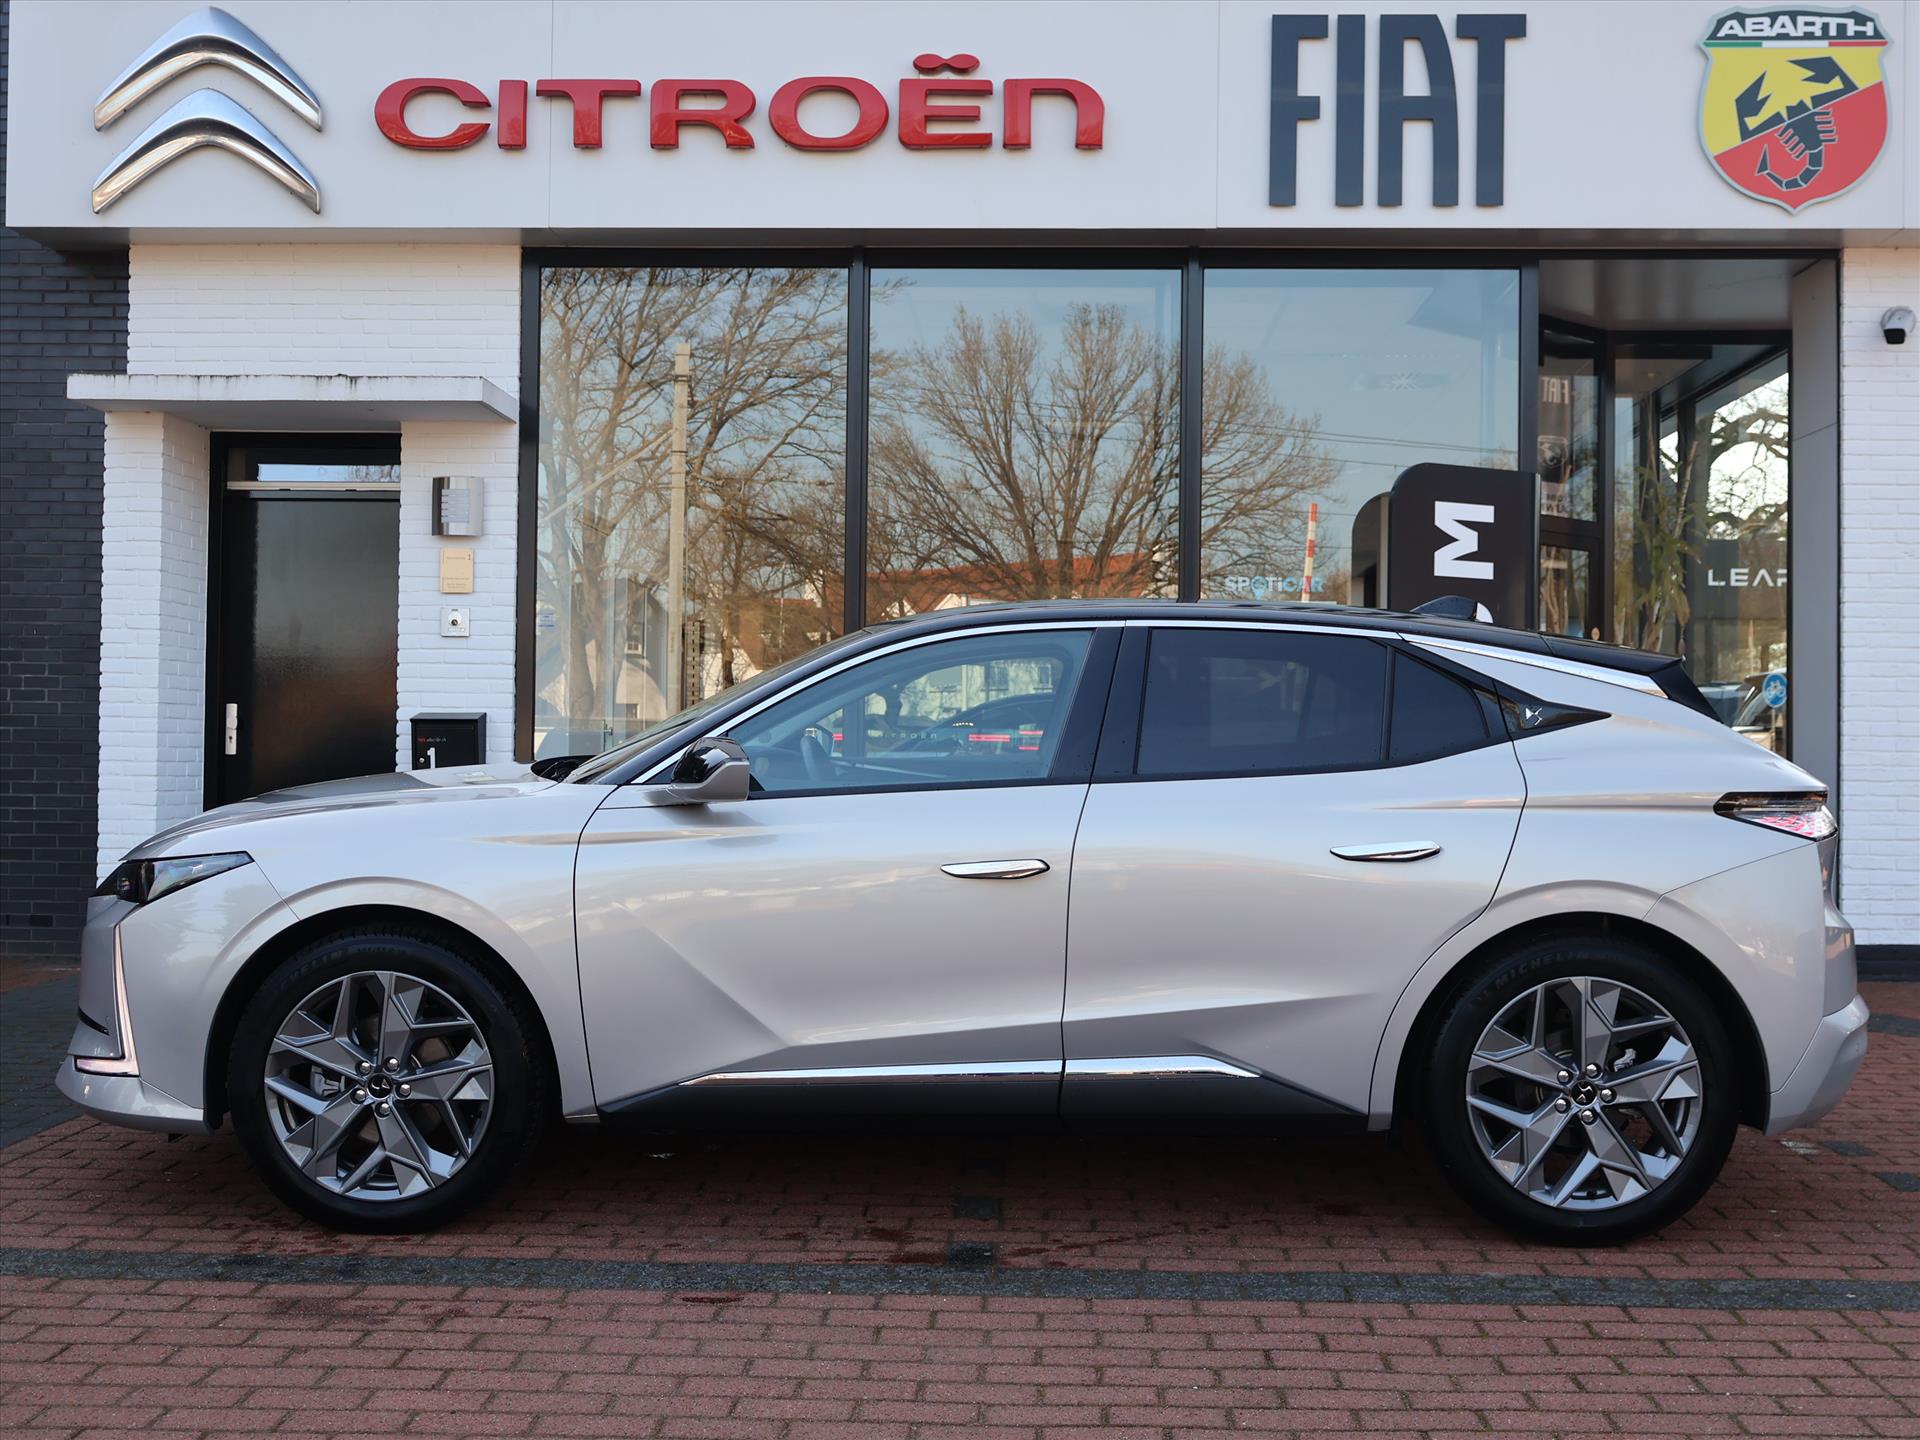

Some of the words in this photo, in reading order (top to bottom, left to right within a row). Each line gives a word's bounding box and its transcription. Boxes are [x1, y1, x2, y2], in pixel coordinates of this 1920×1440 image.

[1716, 15, 1875, 38] ABARTH
[375, 53, 1104, 151] CITROËN
[1269, 14, 1527, 208] FIAT
[427, 747, 436, 769] 1
